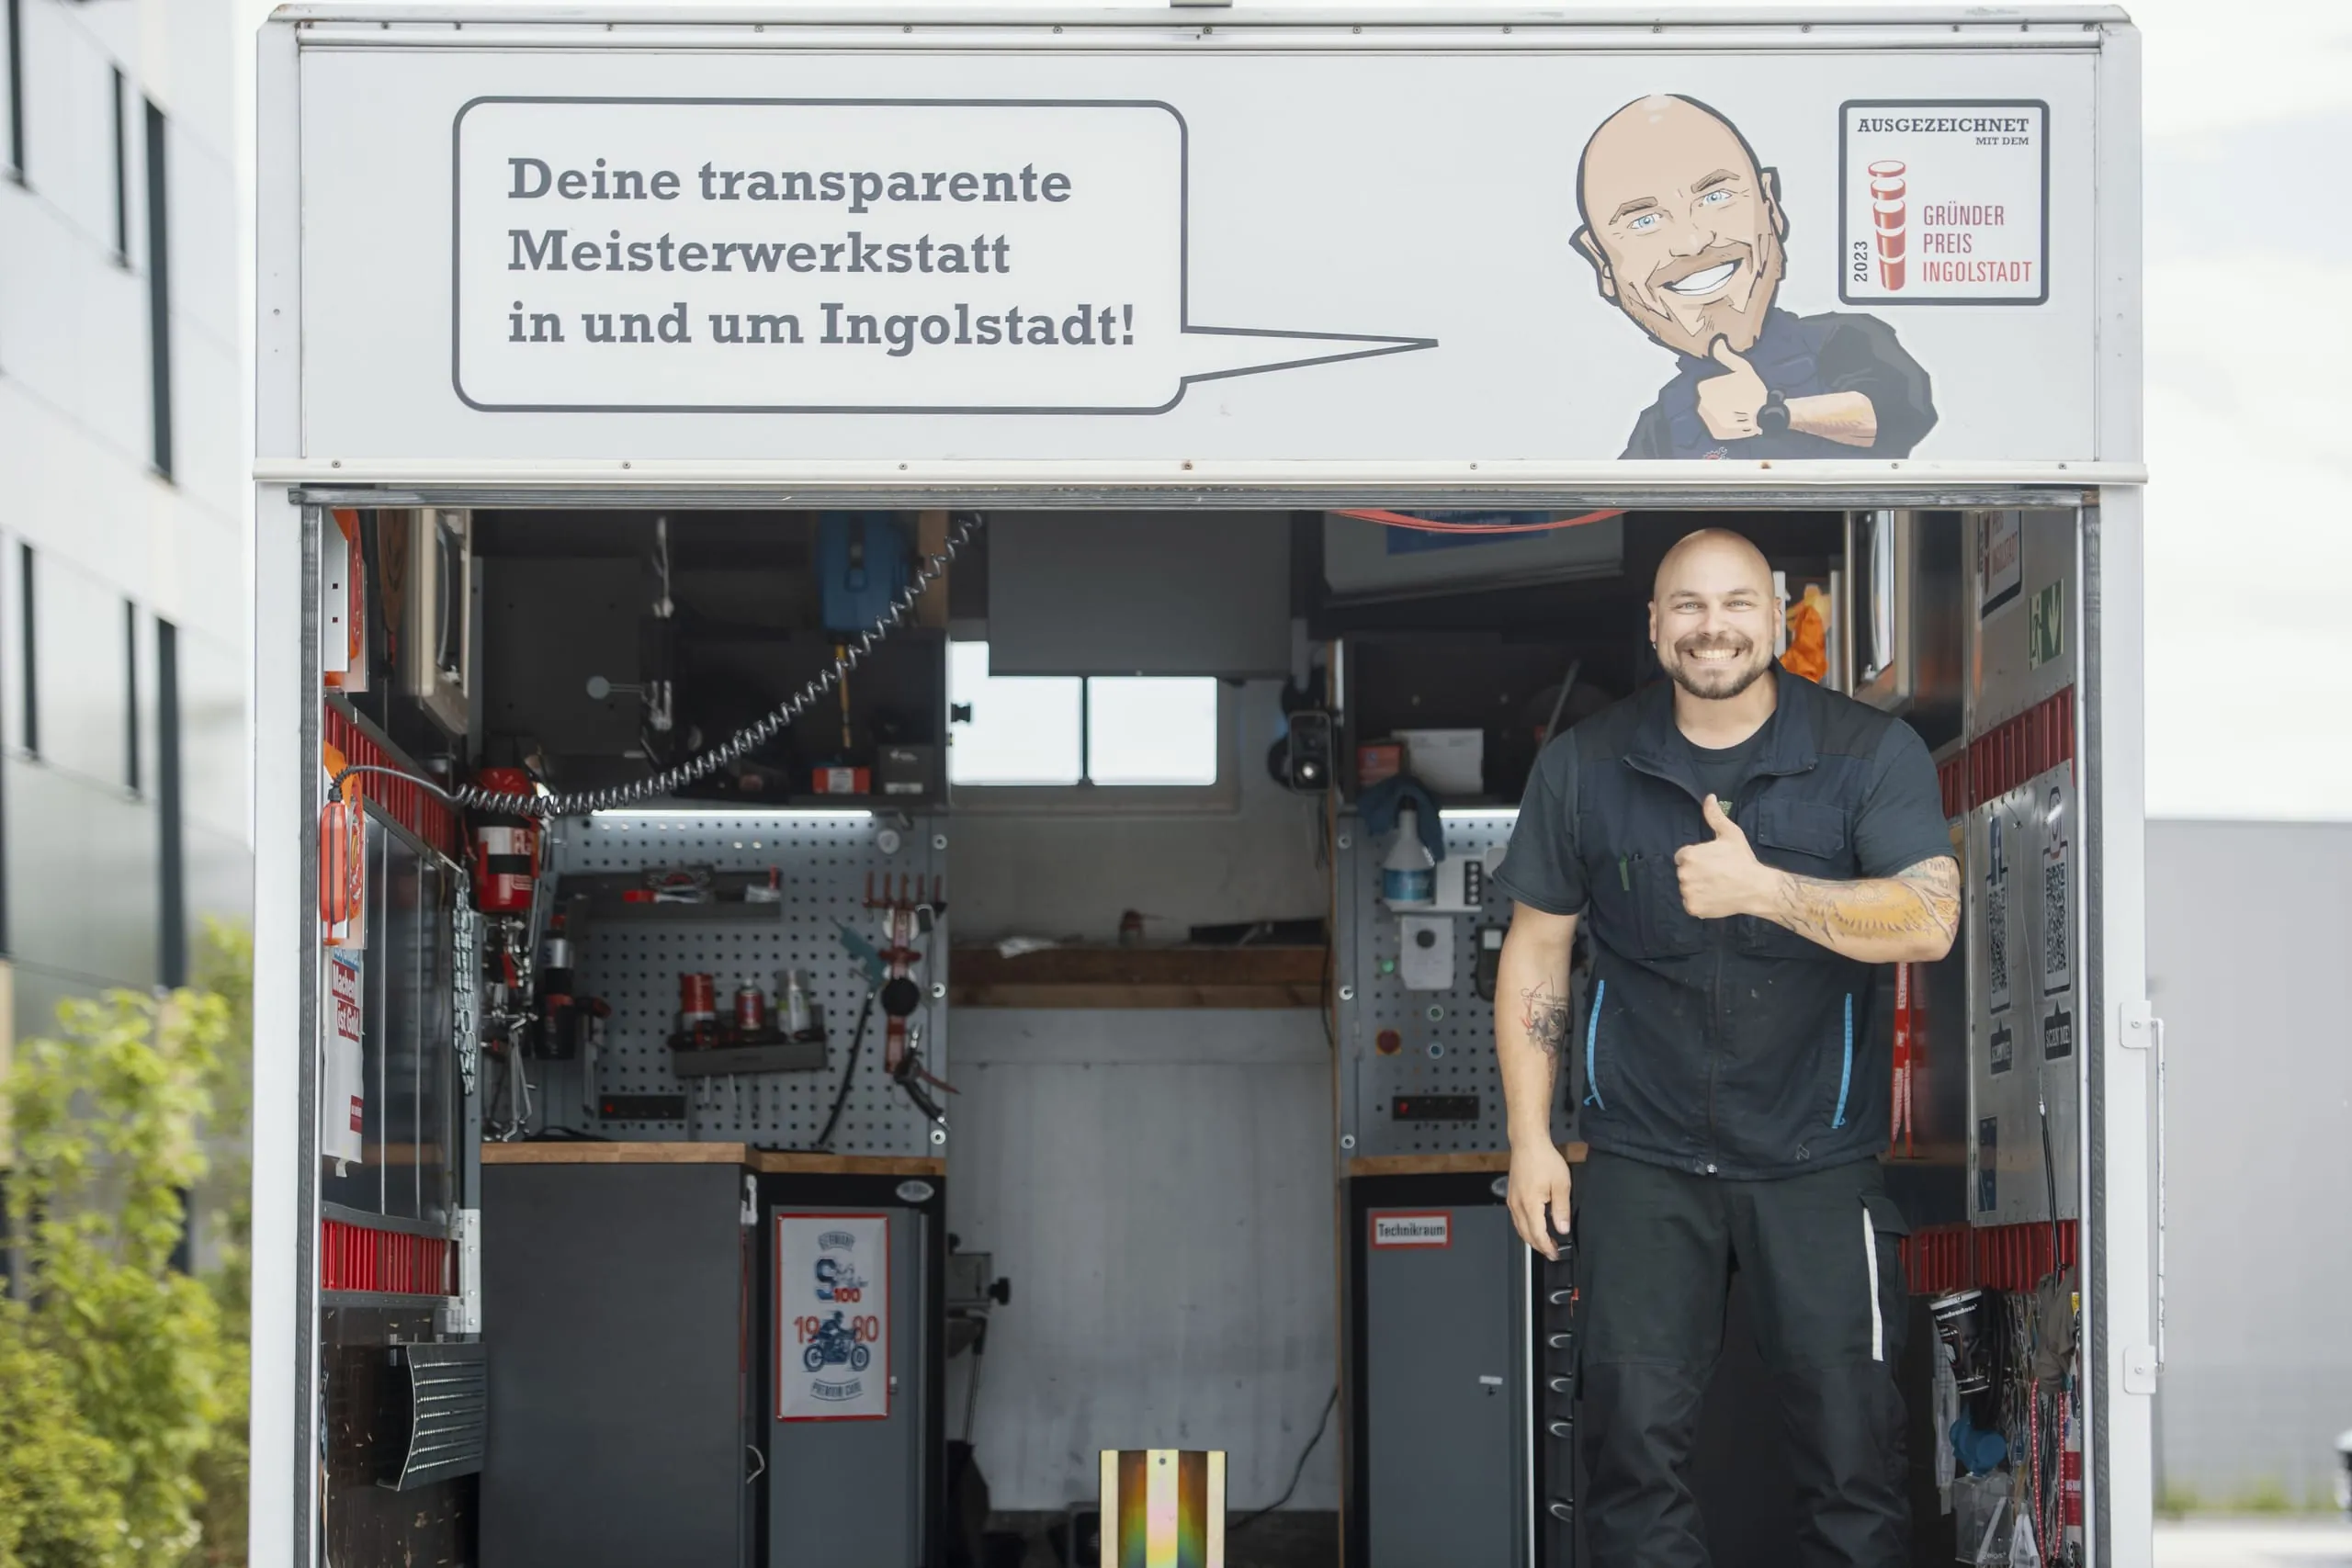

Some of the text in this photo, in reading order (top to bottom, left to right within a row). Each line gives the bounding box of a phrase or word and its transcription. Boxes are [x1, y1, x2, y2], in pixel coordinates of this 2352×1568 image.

[1857, 118, 2030, 132] AUSGEZEICHNET
[1975, 137, 2030, 146] MIT DEM
[508, 157, 1072, 214] Deine transparente
[1923, 200, 2005, 226] GRÜNDER
[508, 230, 1011, 274] Meisterwerkstatt
[1923, 233, 1973, 254] PREIS
[1853, 241, 1868, 283] 2023
[1923, 261, 2032, 282] INGOLSTADT
[508, 300, 1134, 357] in und um Ingolstadt!
[1378, 1223, 1445, 1237] Technikraum
